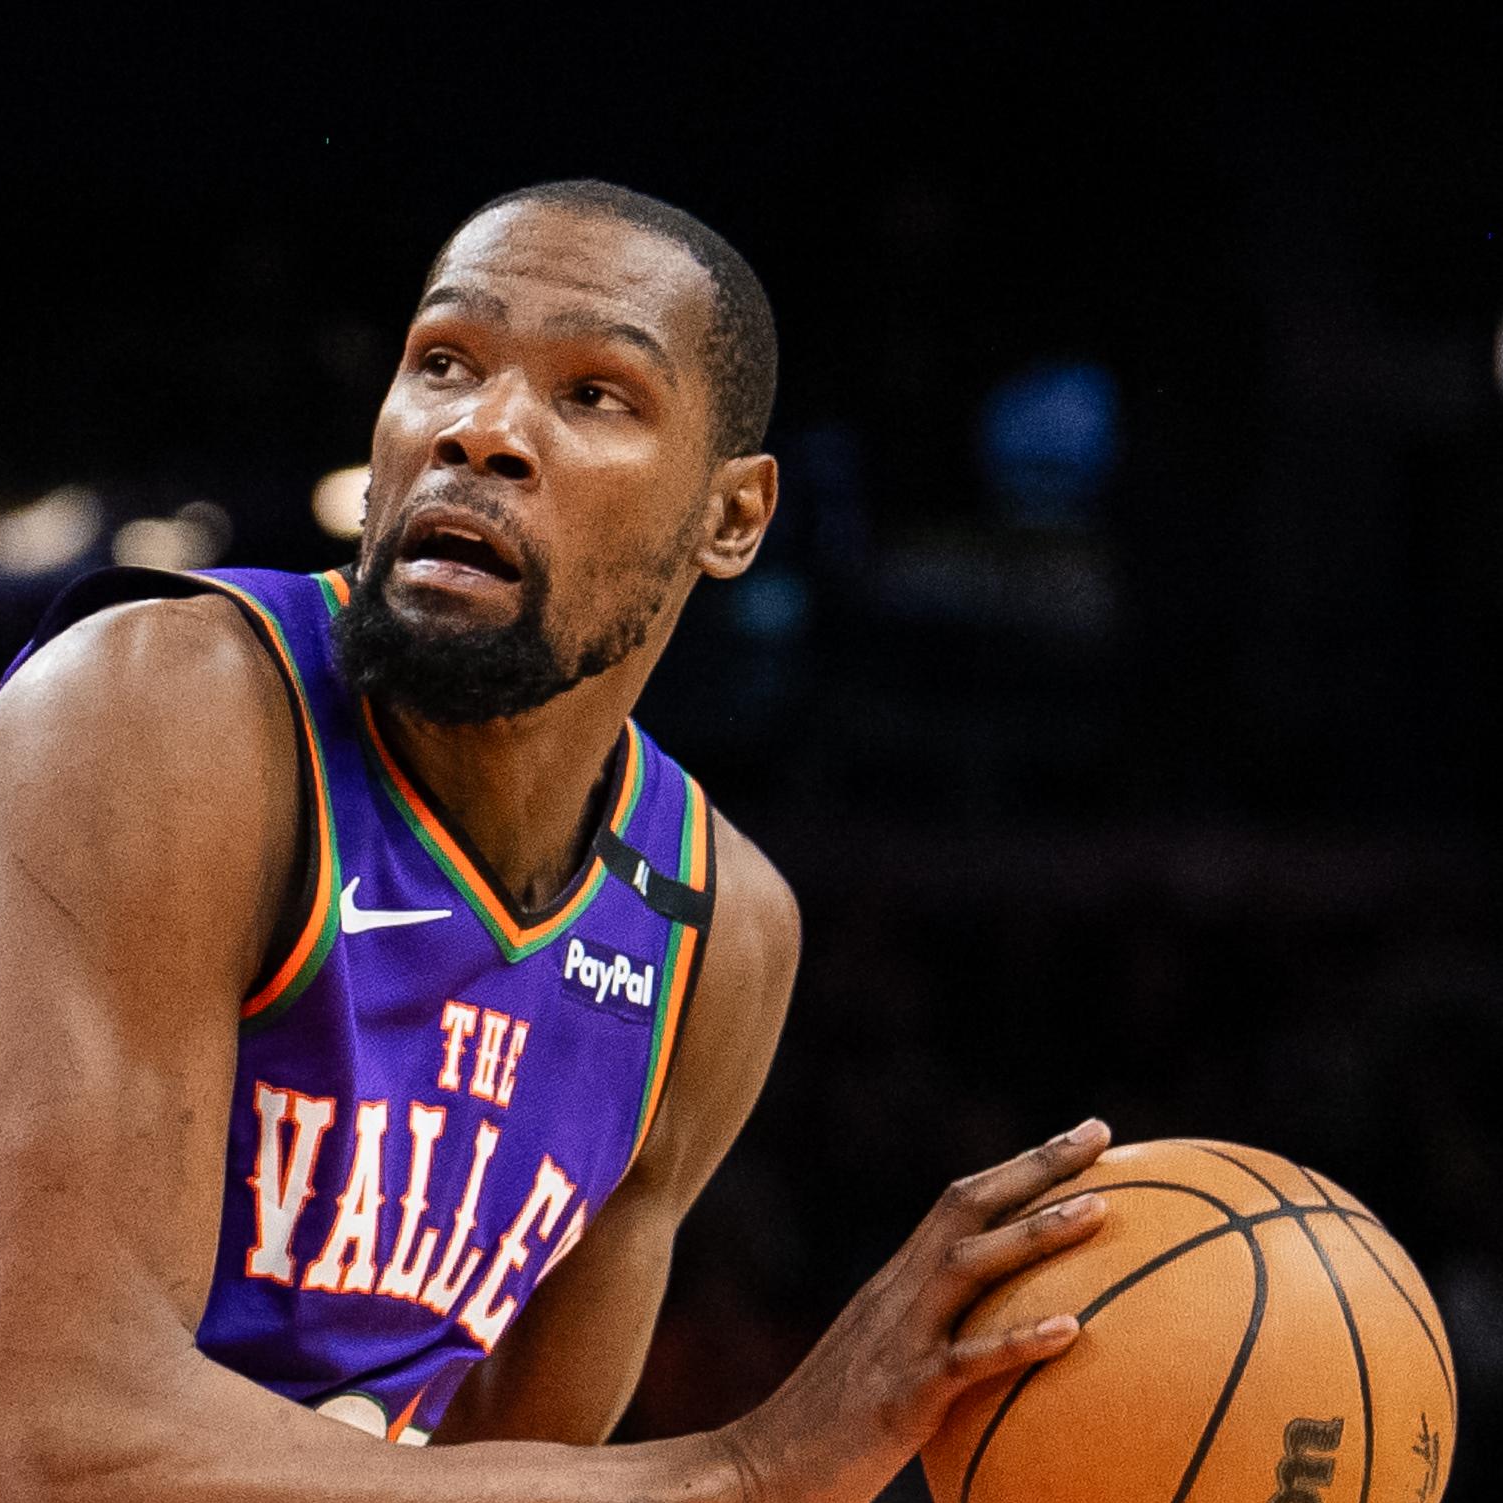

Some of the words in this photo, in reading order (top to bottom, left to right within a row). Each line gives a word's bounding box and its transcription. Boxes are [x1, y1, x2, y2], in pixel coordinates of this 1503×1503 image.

[564, 938, 655, 1007] PayPal
[437, 1000, 531, 1110] THE
[245, 1080, 589, 1357] VALLE
